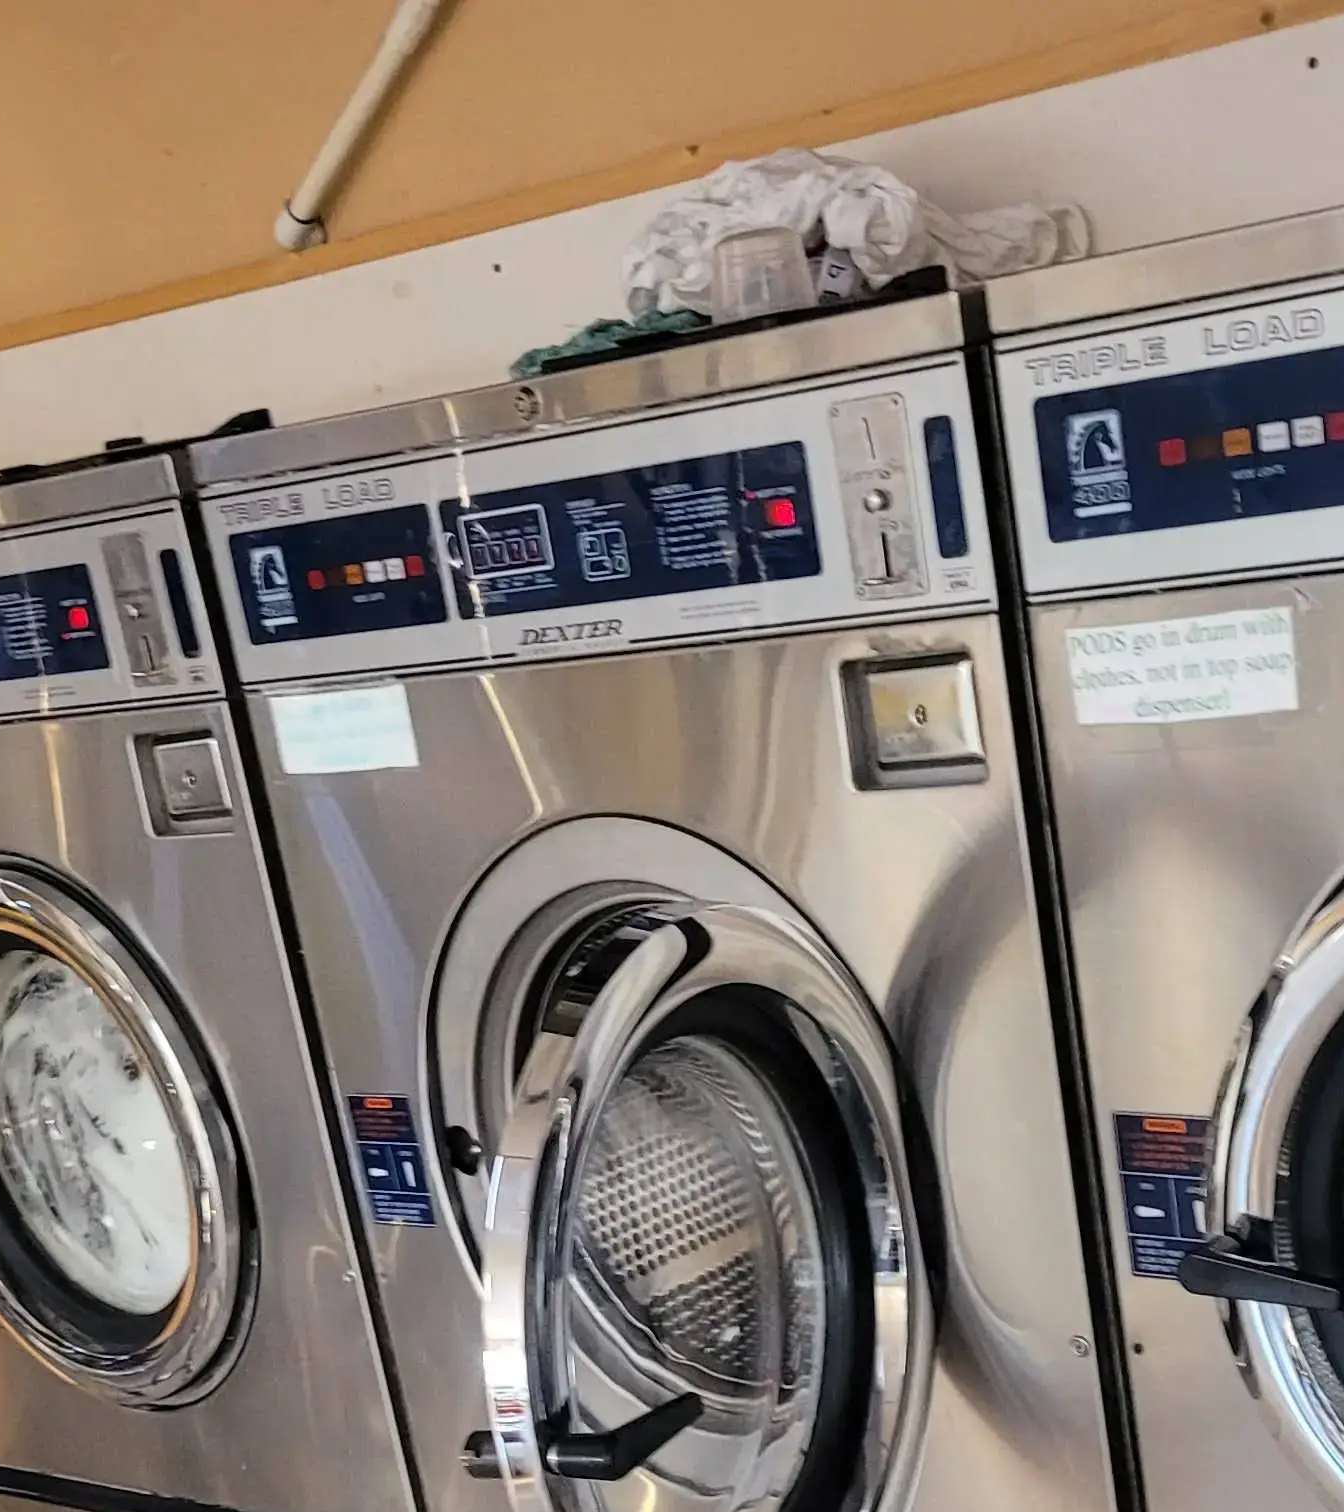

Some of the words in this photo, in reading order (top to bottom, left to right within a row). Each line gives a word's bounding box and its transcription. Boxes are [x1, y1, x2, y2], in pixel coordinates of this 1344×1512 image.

[1024, 336, 1170, 386] TRIPLE
[1202, 307, 1326, 355] LOAD
[320, 477, 396, 510] LOAD
[517, 618, 623, 646] DEXTER
[1068, 630, 1127, 658] PODS
[1131, 632, 1156, 657] go
[1145, 663, 1179, 684] not
